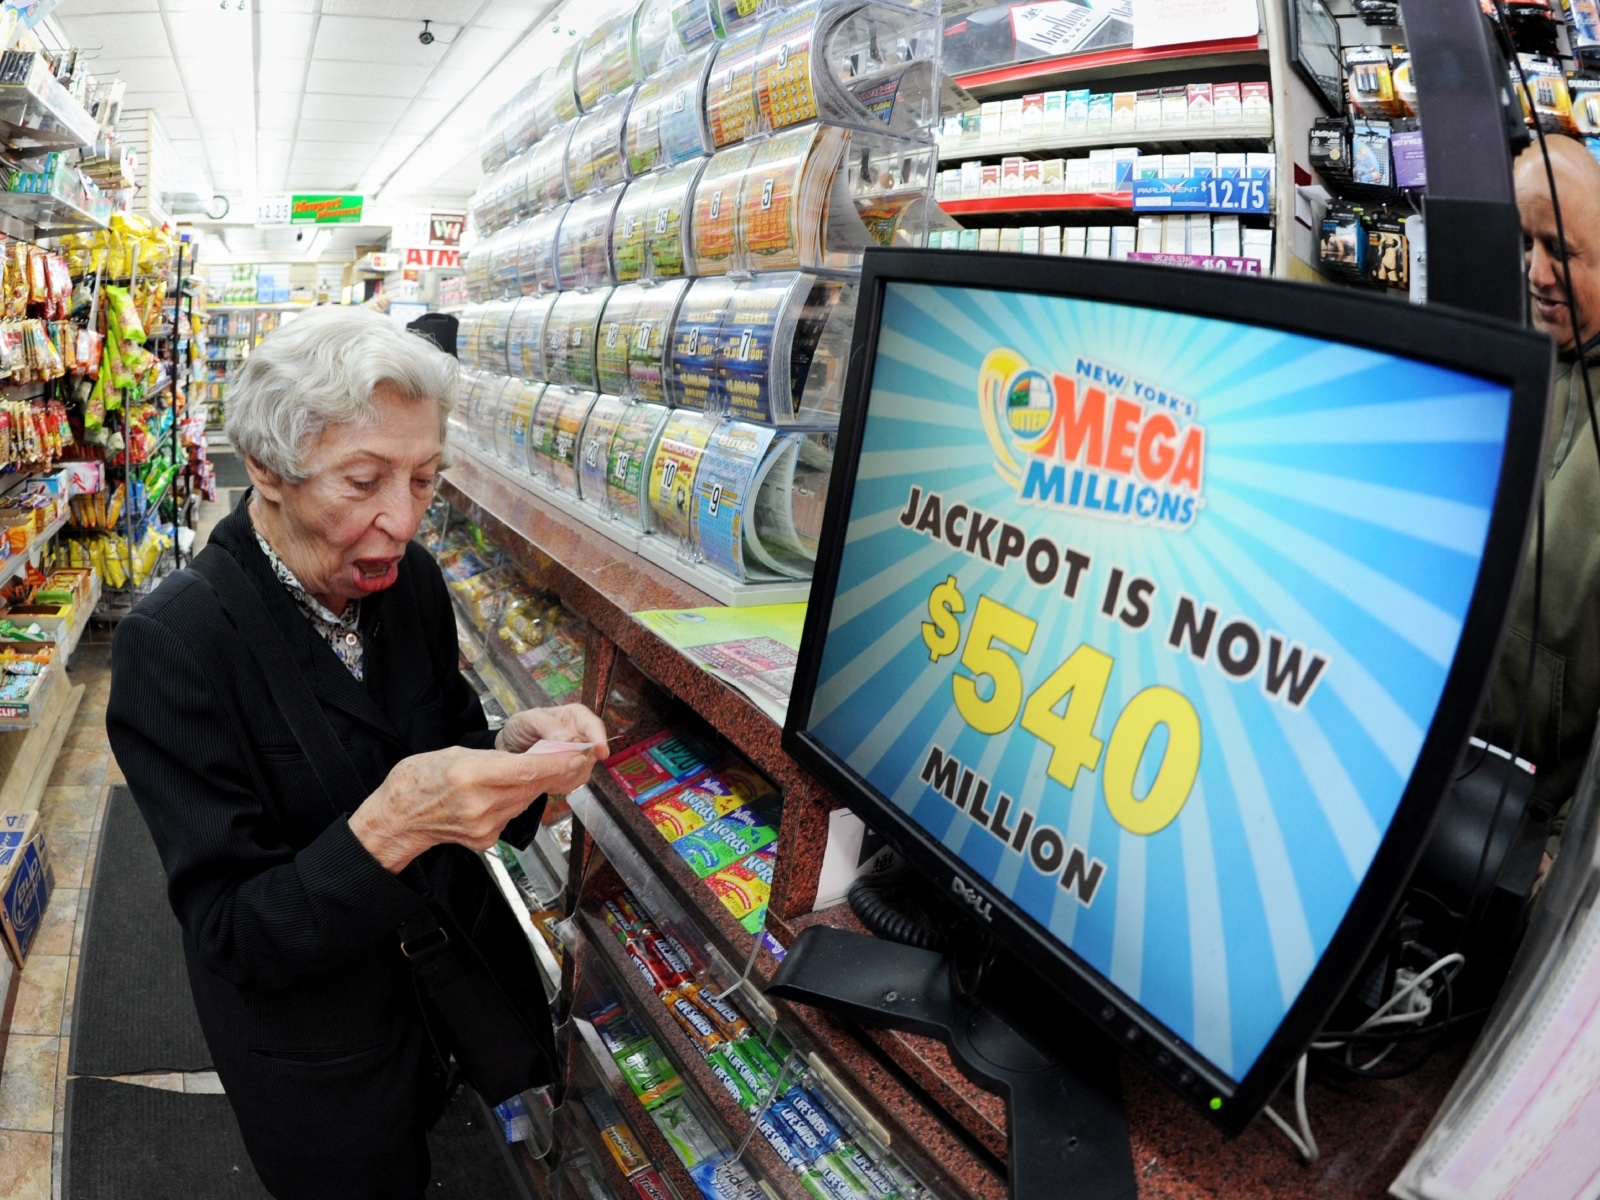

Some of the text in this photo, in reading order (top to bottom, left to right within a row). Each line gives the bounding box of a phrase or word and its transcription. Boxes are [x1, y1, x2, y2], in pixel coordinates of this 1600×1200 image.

[1031, 7, 1092, 45] Marlboro
[1062, 18, 1092, 44] BLACK
[1346, 53, 1386, 62] DURACELL
[1521, 62, 1561, 73] DURACELL
[1201, 180, 1264, 209] $12.75
[1076, 358, 1192, 416] NEW YORK'S
[718, 434, 758, 452] Bingo
[1035, 374, 1202, 490] MEGA
[1021, 460, 1195, 525] MILLIONS
[900, 487, 1326, 707] JACKPOT IS NOW
[0, 708, 17, 717] CLIF
[920, 574, 1202, 836] $540
[615, 755, 663, 794] UP2U
[678, 790, 718, 822] Nerds
[708, 820, 751, 856] Nerds
[919, 747, 1105, 904] MILLION
[18, 857, 38, 905] BUD
[742, 855, 774, 885] NeR
[18, 867, 41, 926] LIGHT
[951, 875, 993, 923] DELL
[608, 1128, 638, 1161] Trident
[638, 1176, 664, 1200] Tride
